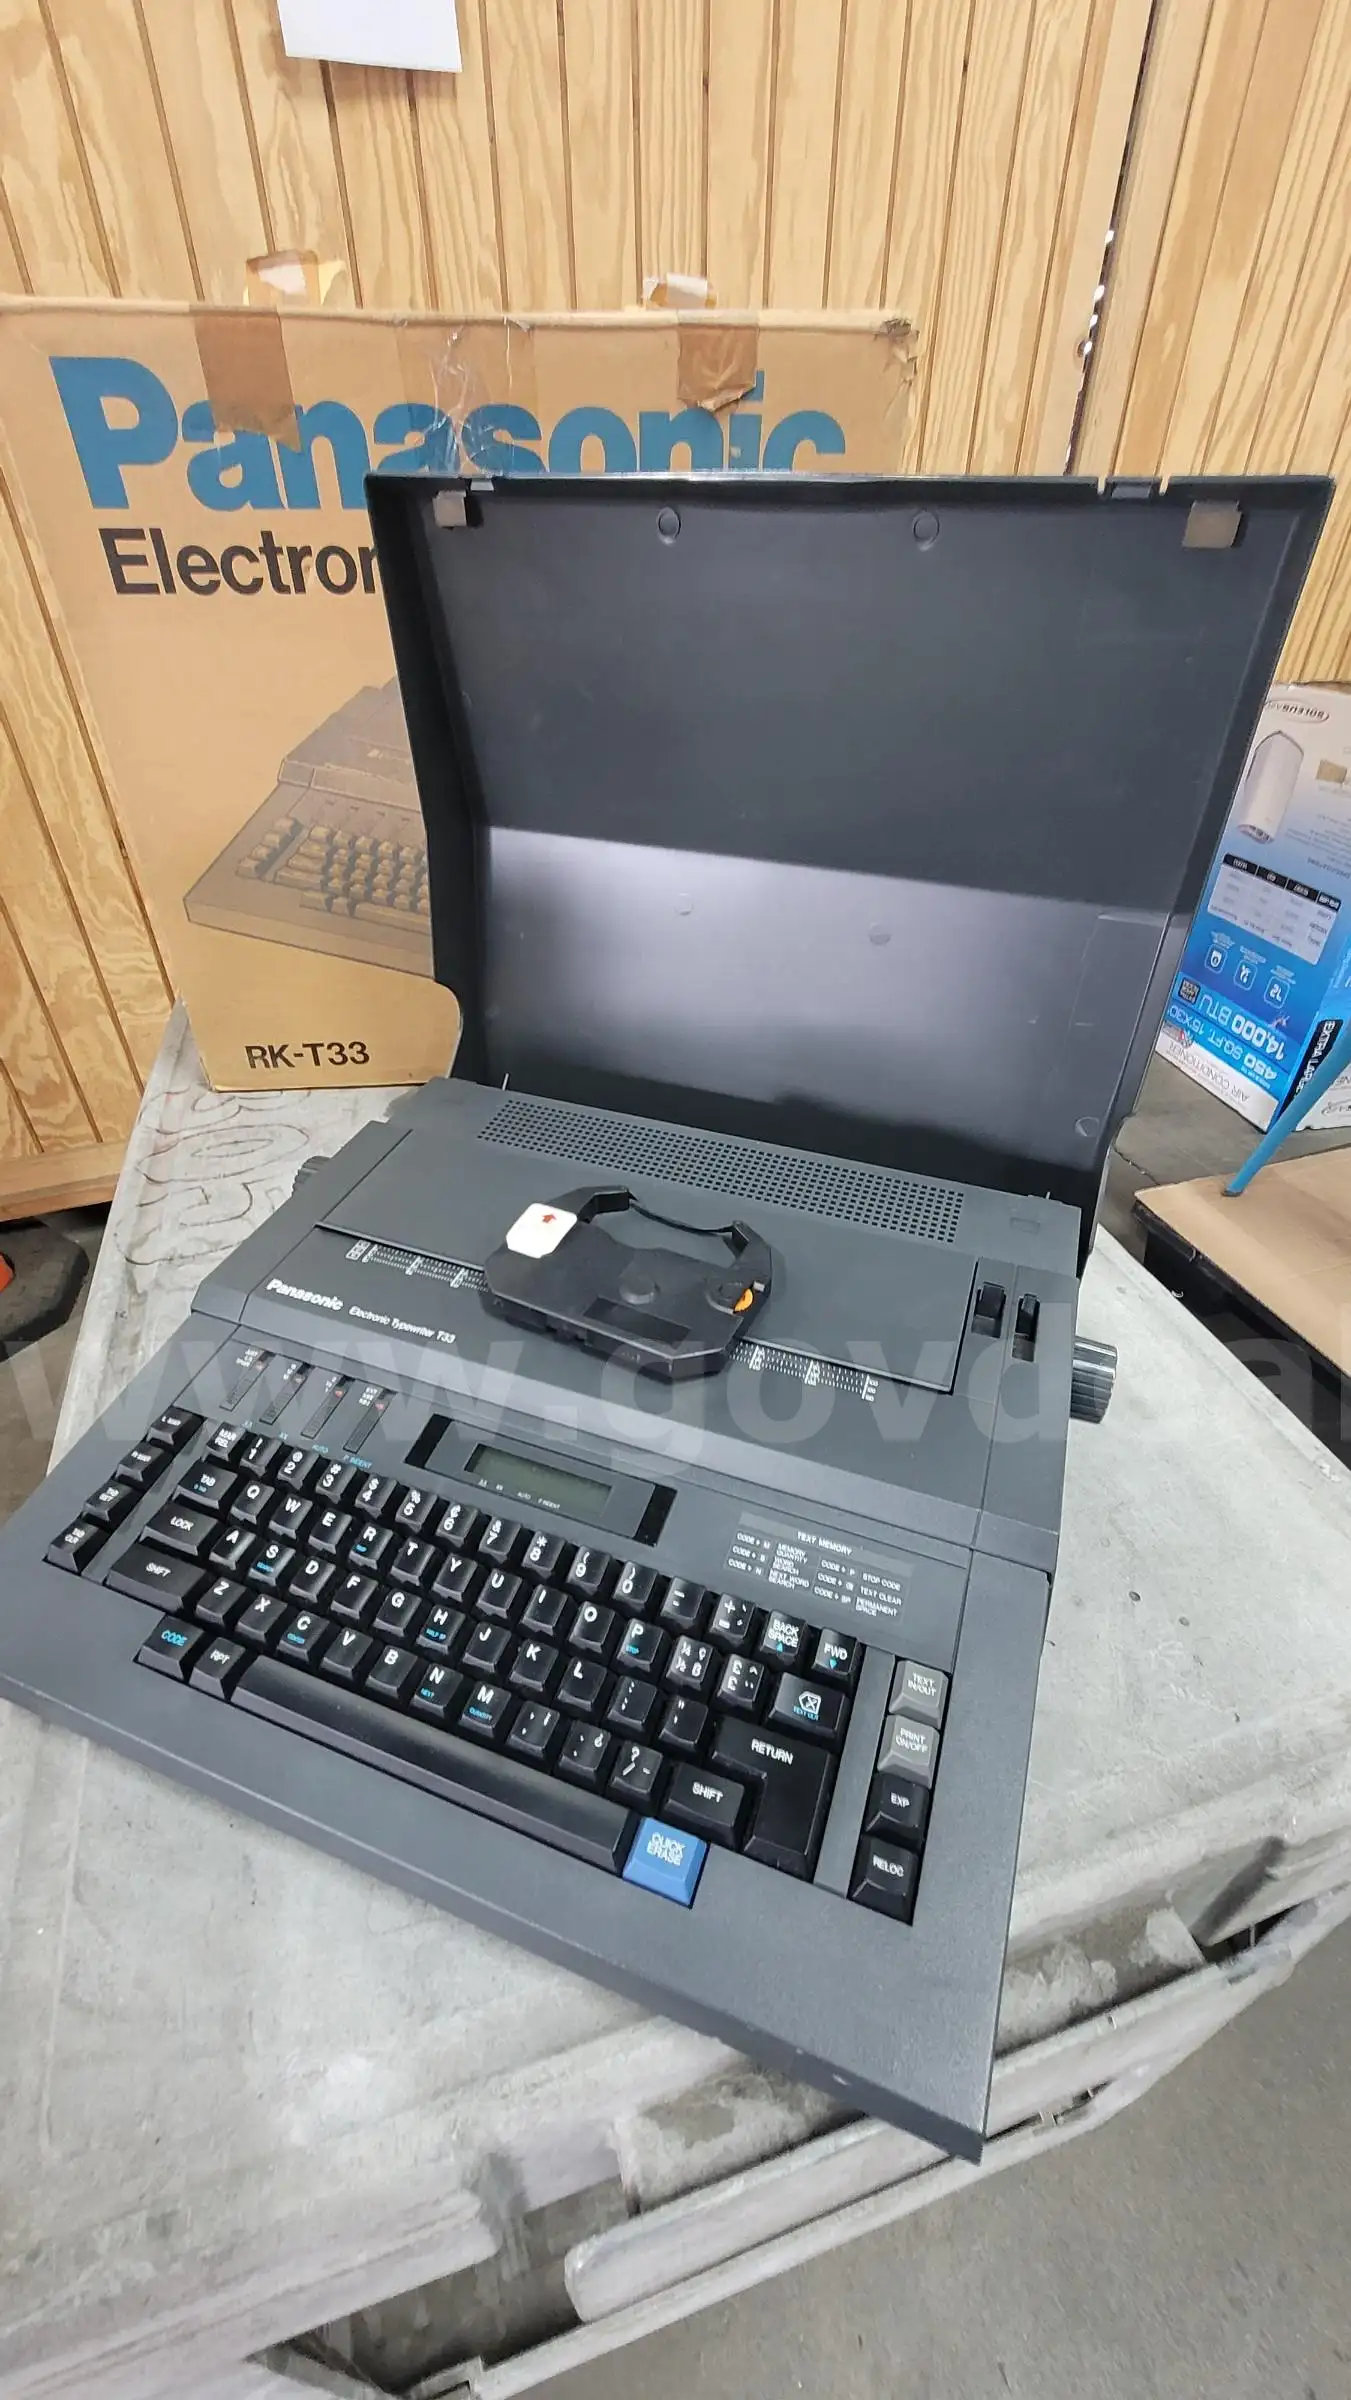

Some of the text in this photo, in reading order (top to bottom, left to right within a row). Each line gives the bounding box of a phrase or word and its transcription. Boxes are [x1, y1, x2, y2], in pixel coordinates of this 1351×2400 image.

[49, 356, 846, 511] Panasonic
[1198, 995, 1285, 1061] 14,000 BTU
[1313, 1020, 1336, 1061] EXTRA
[245, 1040, 370, 1071] RK-T33
[1168, 1038, 1231, 1089] CONDITIONER
[1243, 1052, 1278, 1080] 450
[1231, 1083, 1251, 1103] AIR
[266, 1278, 456, 1344] Panasonic Electronic Typewriter T33
[248, 1446, 257, 1461] 1
[284, 1461, 296, 1475] 2
[330, 1463, 342, 1475] #
[200, 1473, 216, 1487] TAB
[322, 1474, 334, 1488] 3
[368, 1478, 379, 1490] $
[246, 1485, 260, 1500] Q
[362, 1489, 373, 1502] 4
[284, 1497, 302, 1513] W
[403, 1502, 416, 1516] 5
[170, 1515, 194, 1532] LOCK
[322, 1511, 336, 1527] E
[443, 1517, 455, 1531] 6
[225, 1530, 240, 1545] A
[362, 1526, 377, 1542] R
[486, 1532, 498, 1545] 7
[736, 1531, 755, 1545] CODE
[407, 1541, 419, 1556] T
[777, 1543, 807, 1558] MEMORY
[797, 1530, 853, 1556] TEXT MEMORY
[265, 1544, 279, 1559] S
[530, 1546, 542, 1561] 8
[732, 1545, 751, 1559] CODE
[776, 1549, 808, 1565] QUANTITY
[145, 1561, 172, 1577] SHIFT
[305, 1560, 319, 1575] D
[450, 1557, 463, 1573] Y
[575, 1562, 587, 1578] 9
[728, 1558, 747, 1571] CODE
[755, 1567, 762, 1576] N
[772, 1563, 800, 1577] SEARCH
[774, 1556, 794, 1569] WORD
[820, 1559, 840, 1573] CODE
[346, 1575, 361, 1589] F
[491, 1572, 505, 1589] U
[622, 1578, 634, 1594] 0
[768, 1576, 796, 1590] SEARCH
[790, 1575, 810, 1589] WORD
[817, 1571, 837, 1586] CODE
[862, 1572, 901, 1592] STOP CODE
[213, 1580, 230, 1596] Z
[813, 1585, 834, 1600] CODE
[860, 1585, 878, 1600] TEXT
[878, 1591, 902, 1607] CLEAR
[254, 1596, 271, 1612] X
[391, 1591, 406, 1608] G
[538, 1591, 546, 1604] I
[584, 1605, 598, 1623] O
[724, 1599, 736, 1614] +
[855, 1603, 878, 1617] SPACE
[856, 1596, 898, 1617] PERMANENT
[297, 1615, 311, 1631] C
[433, 1608, 449, 1625] H
[479, 1627, 492, 1642] J
[631, 1623, 644, 1638] P
[773, 1618, 800, 1637] BACK
[161, 1629, 188, 1647] CODE
[342, 1630, 356, 1646] V
[767, 1630, 799, 1648] SPACE
[210, 1648, 231, 1664] RPT
[384, 1649, 399, 1665] B
[526, 1643, 542, 1661] K
[823, 1642, 848, 1661] FWD
[429, 1666, 445, 1685] N
[573, 1661, 583, 1680] L
[913, 1672, 935, 1688] TEXT
[476, 1685, 495, 1704] M
[907, 1680, 937, 1697] IN/OUT
[900, 1727, 927, 1744] PRINT
[750, 1737, 795, 1766] RETURN
[895, 1735, 928, 1754] ON/OFF
[631, 1745, 640, 1762] ?
[692, 1780, 724, 1804] SHIFT
[890, 1792, 911, 1809] EXP
[651, 1831, 687, 1853] QUICK
[646, 1841, 683, 1867] ERASE
[872, 1854, 905, 1878] RELOC
